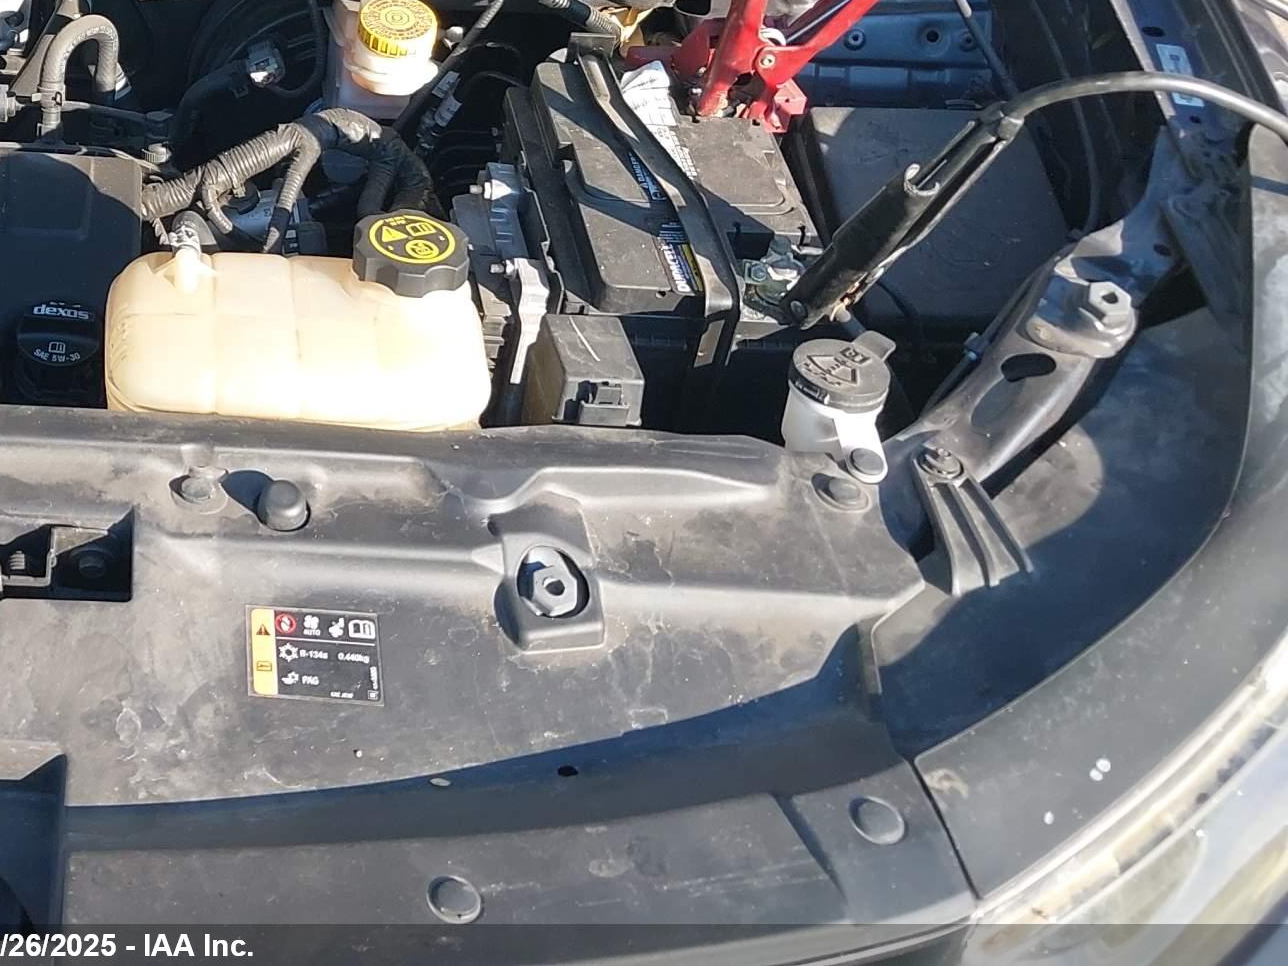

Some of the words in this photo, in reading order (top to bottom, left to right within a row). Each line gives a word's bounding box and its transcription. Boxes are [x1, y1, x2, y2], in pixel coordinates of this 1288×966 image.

[33, 304, 89, 320] dexos
[34, 348, 50, 361] SAE
[52, 352, 81, 362] 5W-30
[302, 675, 319, 685] PAG
